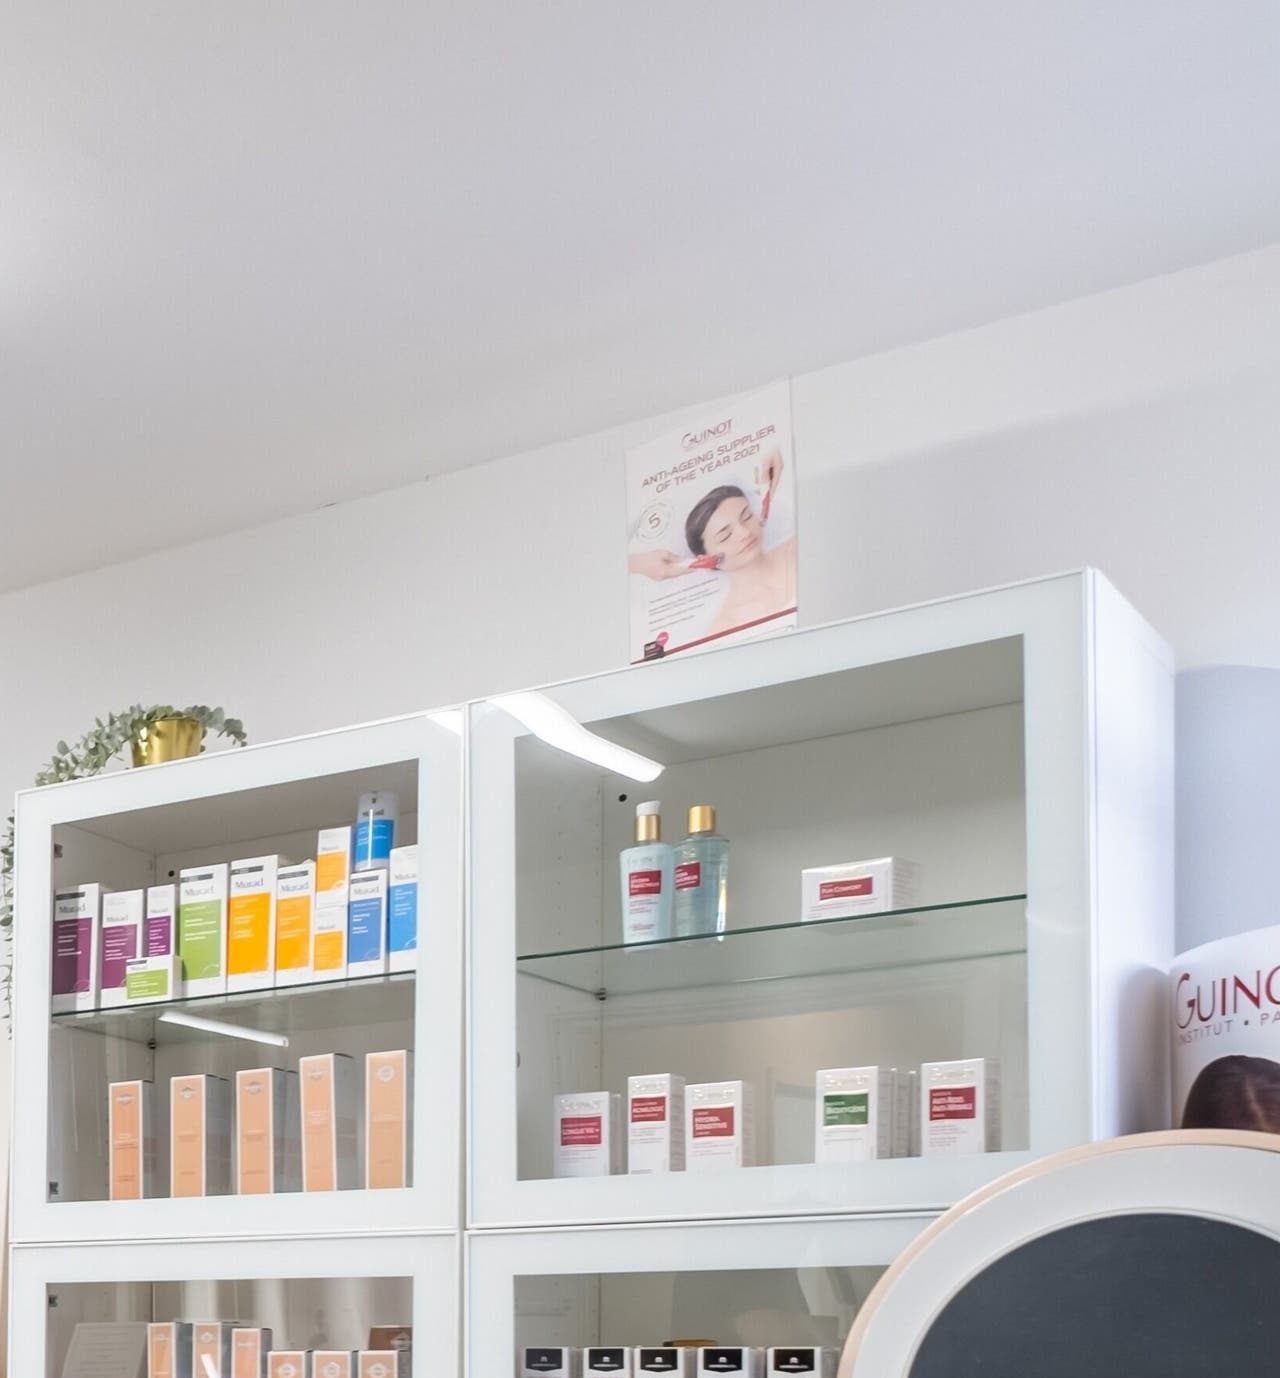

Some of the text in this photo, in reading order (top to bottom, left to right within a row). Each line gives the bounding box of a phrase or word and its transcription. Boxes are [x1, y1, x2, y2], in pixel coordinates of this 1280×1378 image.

[681, 418, 734, 449] GUINOT
[642, 424, 776, 488] ANTI-AGEING SUPPLIER
[656, 443, 760, 493] OF THE YEAR 2021
[184, 885, 215, 897] Murad
[235, 877, 264, 889] Murad
[280, 881, 310, 892] Murad
